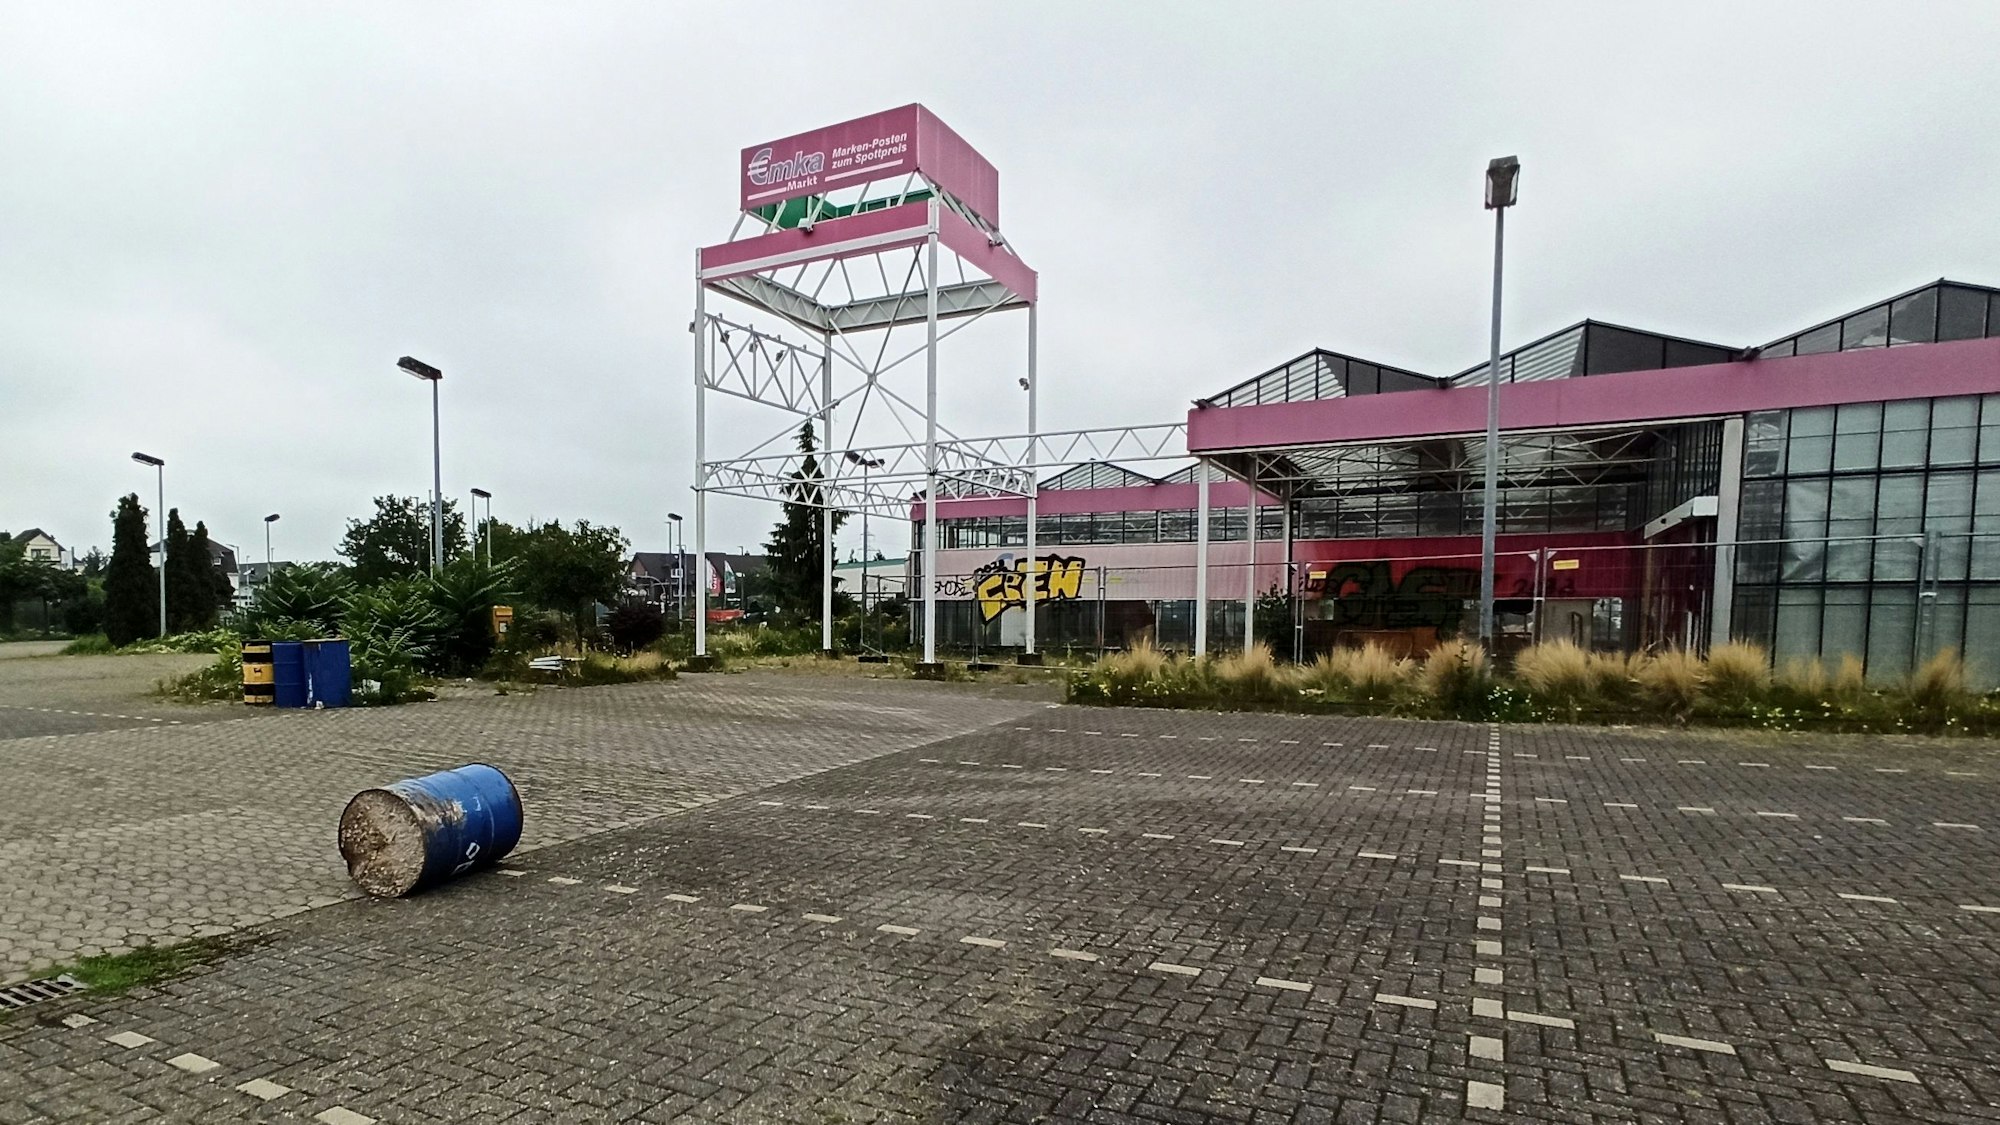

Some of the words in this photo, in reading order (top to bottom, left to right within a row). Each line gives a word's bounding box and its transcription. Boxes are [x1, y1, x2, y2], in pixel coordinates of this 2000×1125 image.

[832, 132, 908, 158] Marken-Posten
[832, 157, 852, 169] zum
[854, 143, 908, 165] Spottpreis
[786, 175, 818, 192] Markt
